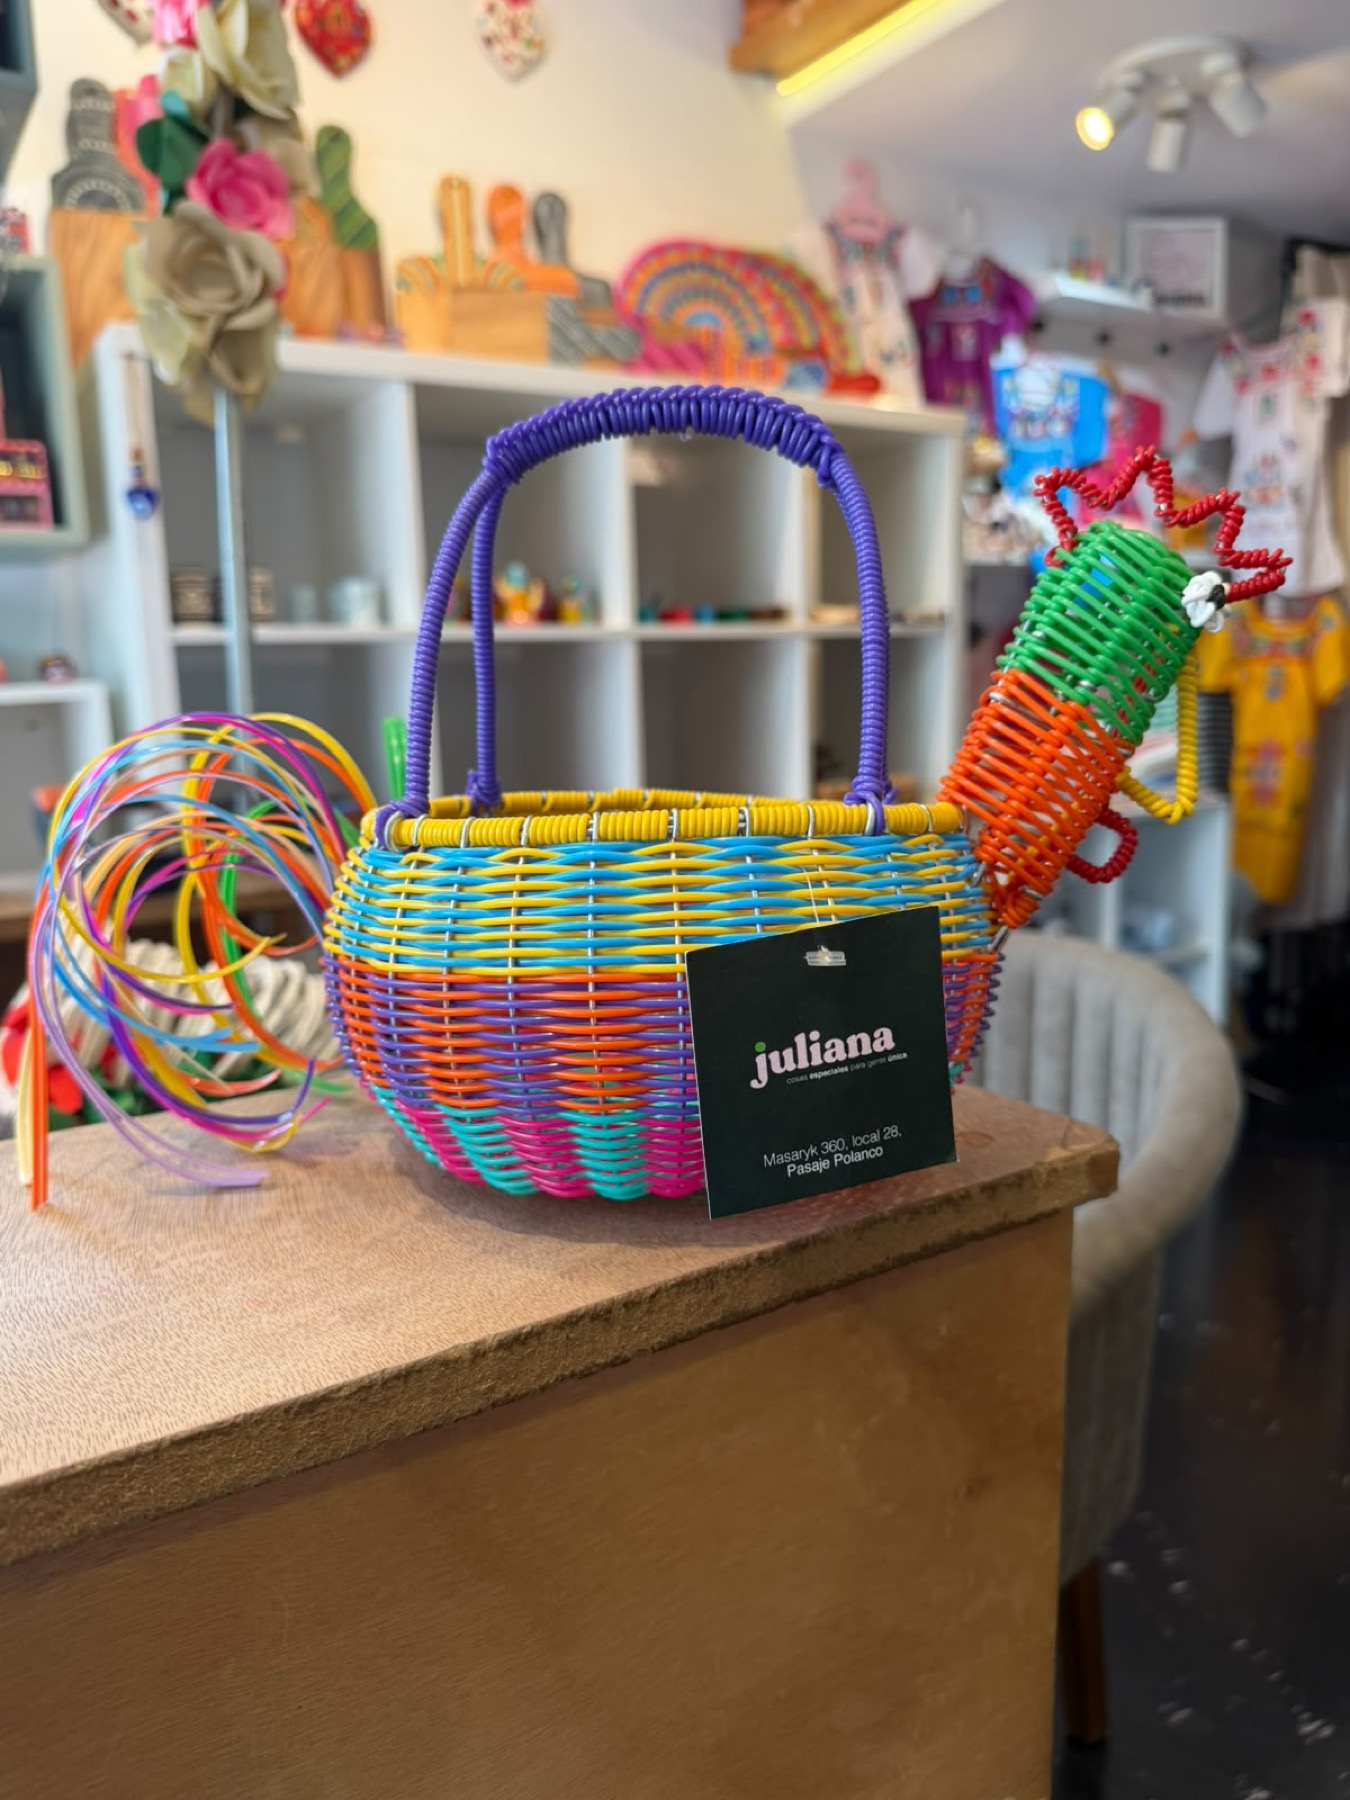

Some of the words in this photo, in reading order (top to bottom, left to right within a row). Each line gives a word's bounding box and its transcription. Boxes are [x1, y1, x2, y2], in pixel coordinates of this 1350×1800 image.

[750, 1027, 895, 1089] juliana
[809, 1065, 849, 1080] especiales
[850, 1062, 866, 1073] para
[867, 1057, 887, 1069] gente
[887, 1052, 908, 1063] única
[763, 1144, 818, 1168] Masaryk
[852, 1129, 881, 1147] local
[787, 1158, 830, 1177] Pasaje
[834, 1146, 883, 1167] Polanco
